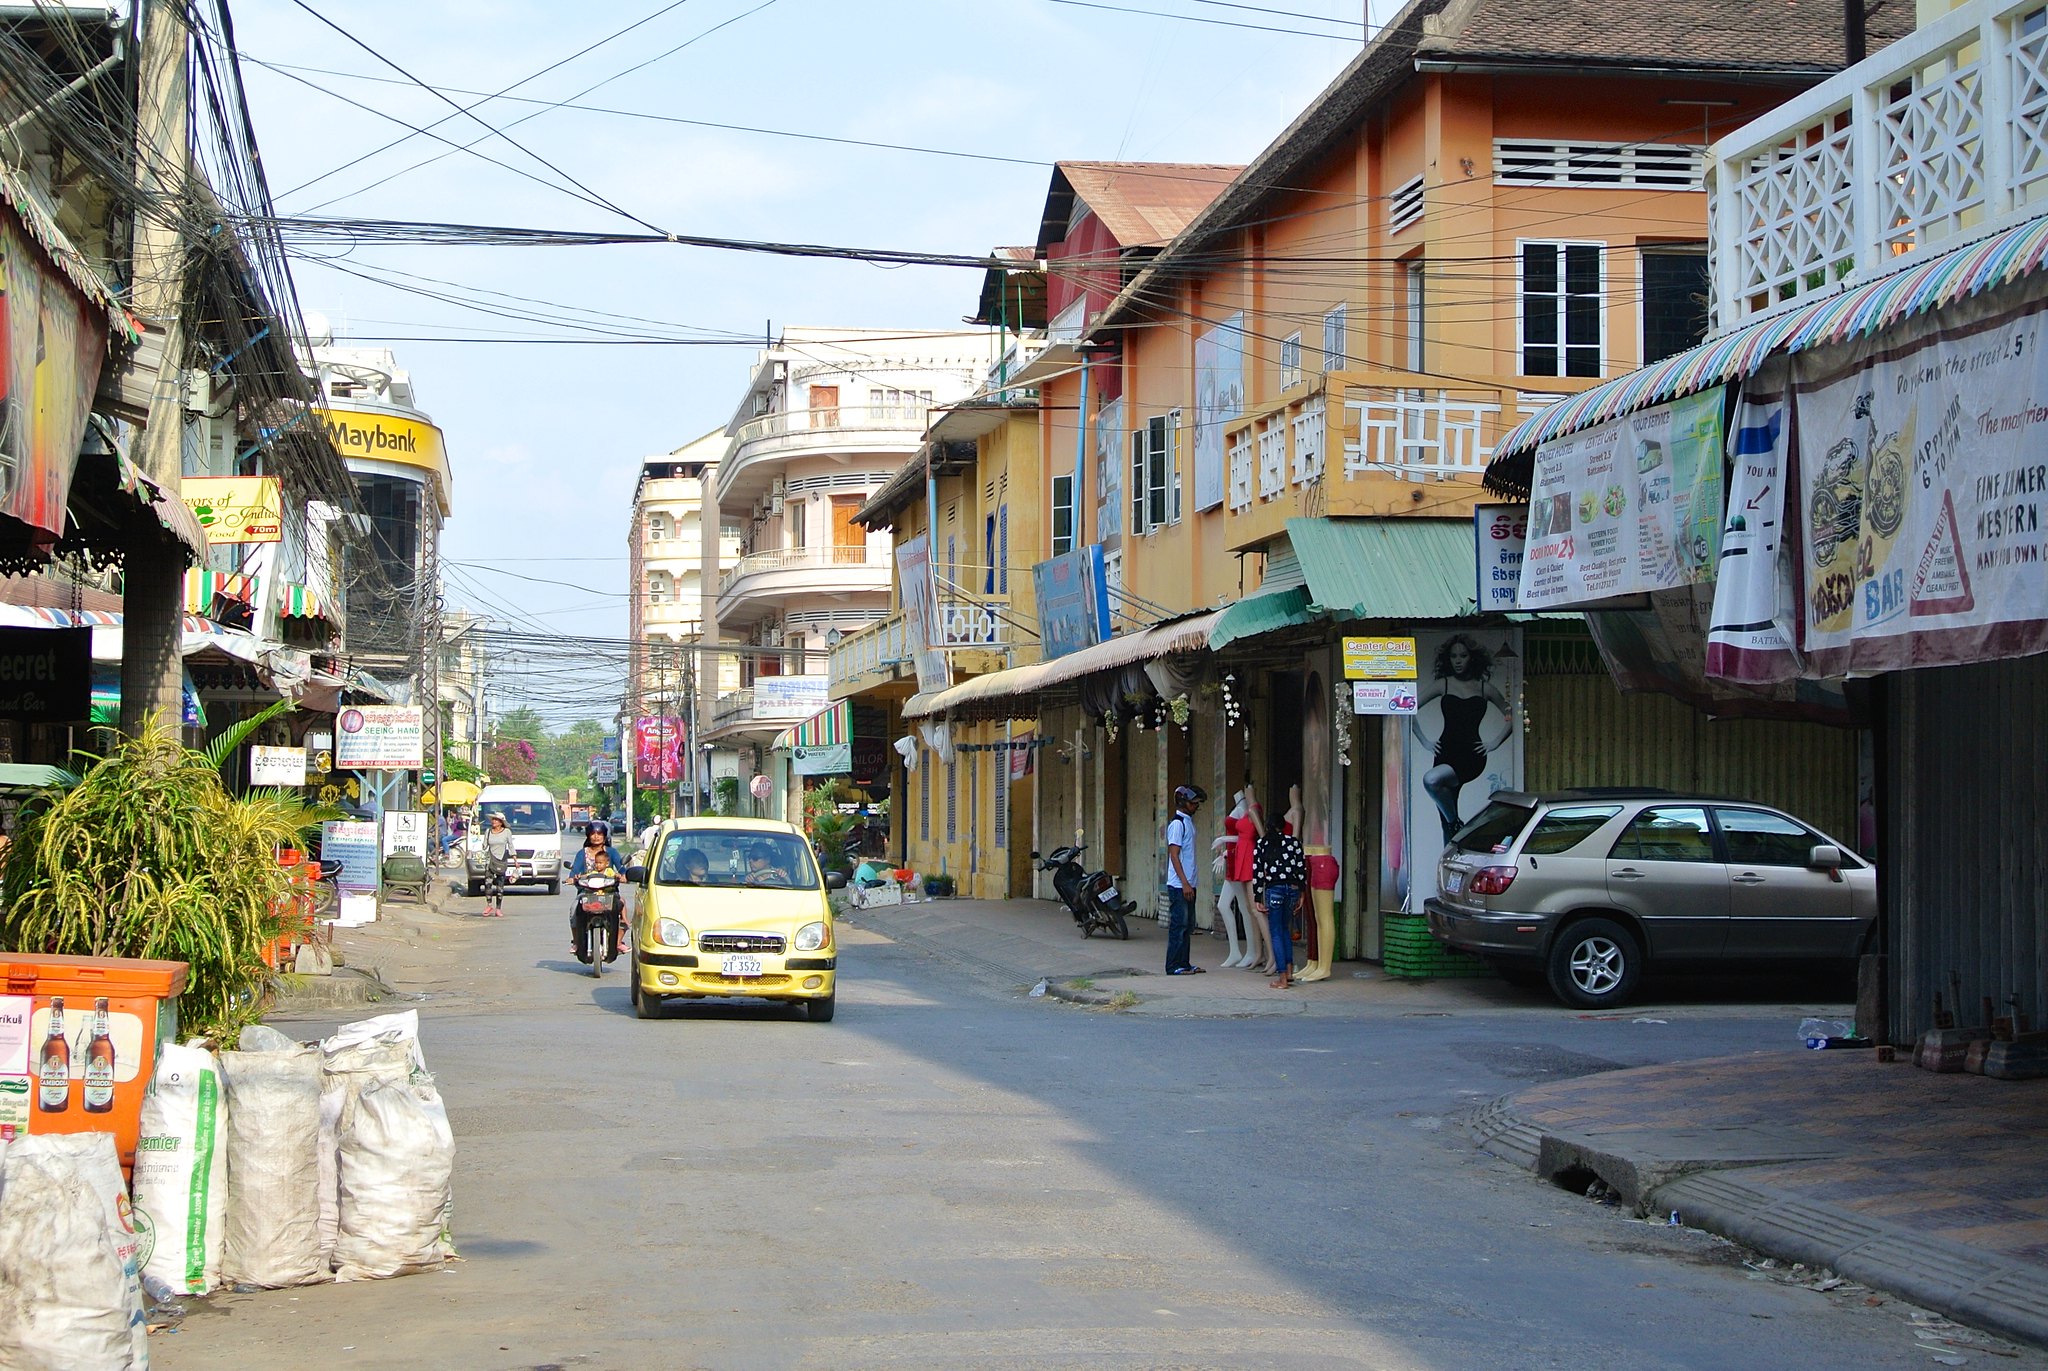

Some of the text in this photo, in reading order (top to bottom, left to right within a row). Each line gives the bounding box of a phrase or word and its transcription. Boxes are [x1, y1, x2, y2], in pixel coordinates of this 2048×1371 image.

[1944, 354, 1966, 377] the
[1969, 343, 2002, 373] street
[1977, 407, 1998, 436] The
[327, 422, 416, 453] Maybank
[1589, 454, 1604, 464] Street
[1914, 426, 1943, 475] HAPPY
[1746, 465, 1763, 478] YOU
[1935, 453, 1946, 478] TO
[1976, 473, 2001, 504] FINE
[225, 505, 275, 528] India
[1976, 503, 2037, 541] WESTERN
[1911, 503, 1949, 600] INFORMATION
[2014, 544, 2038, 564] OWN
[1526, 588, 1539, 599] Best
[1865, 567, 1905, 621] BAR
[1347, 641, 1383, 650] Center
[758, 699, 804, 708] PARIS
[365, 727, 420, 735] SEEING HAND
[752, 782, 771, 791] STOP
[192, 1217, 202, 1246] Premier
